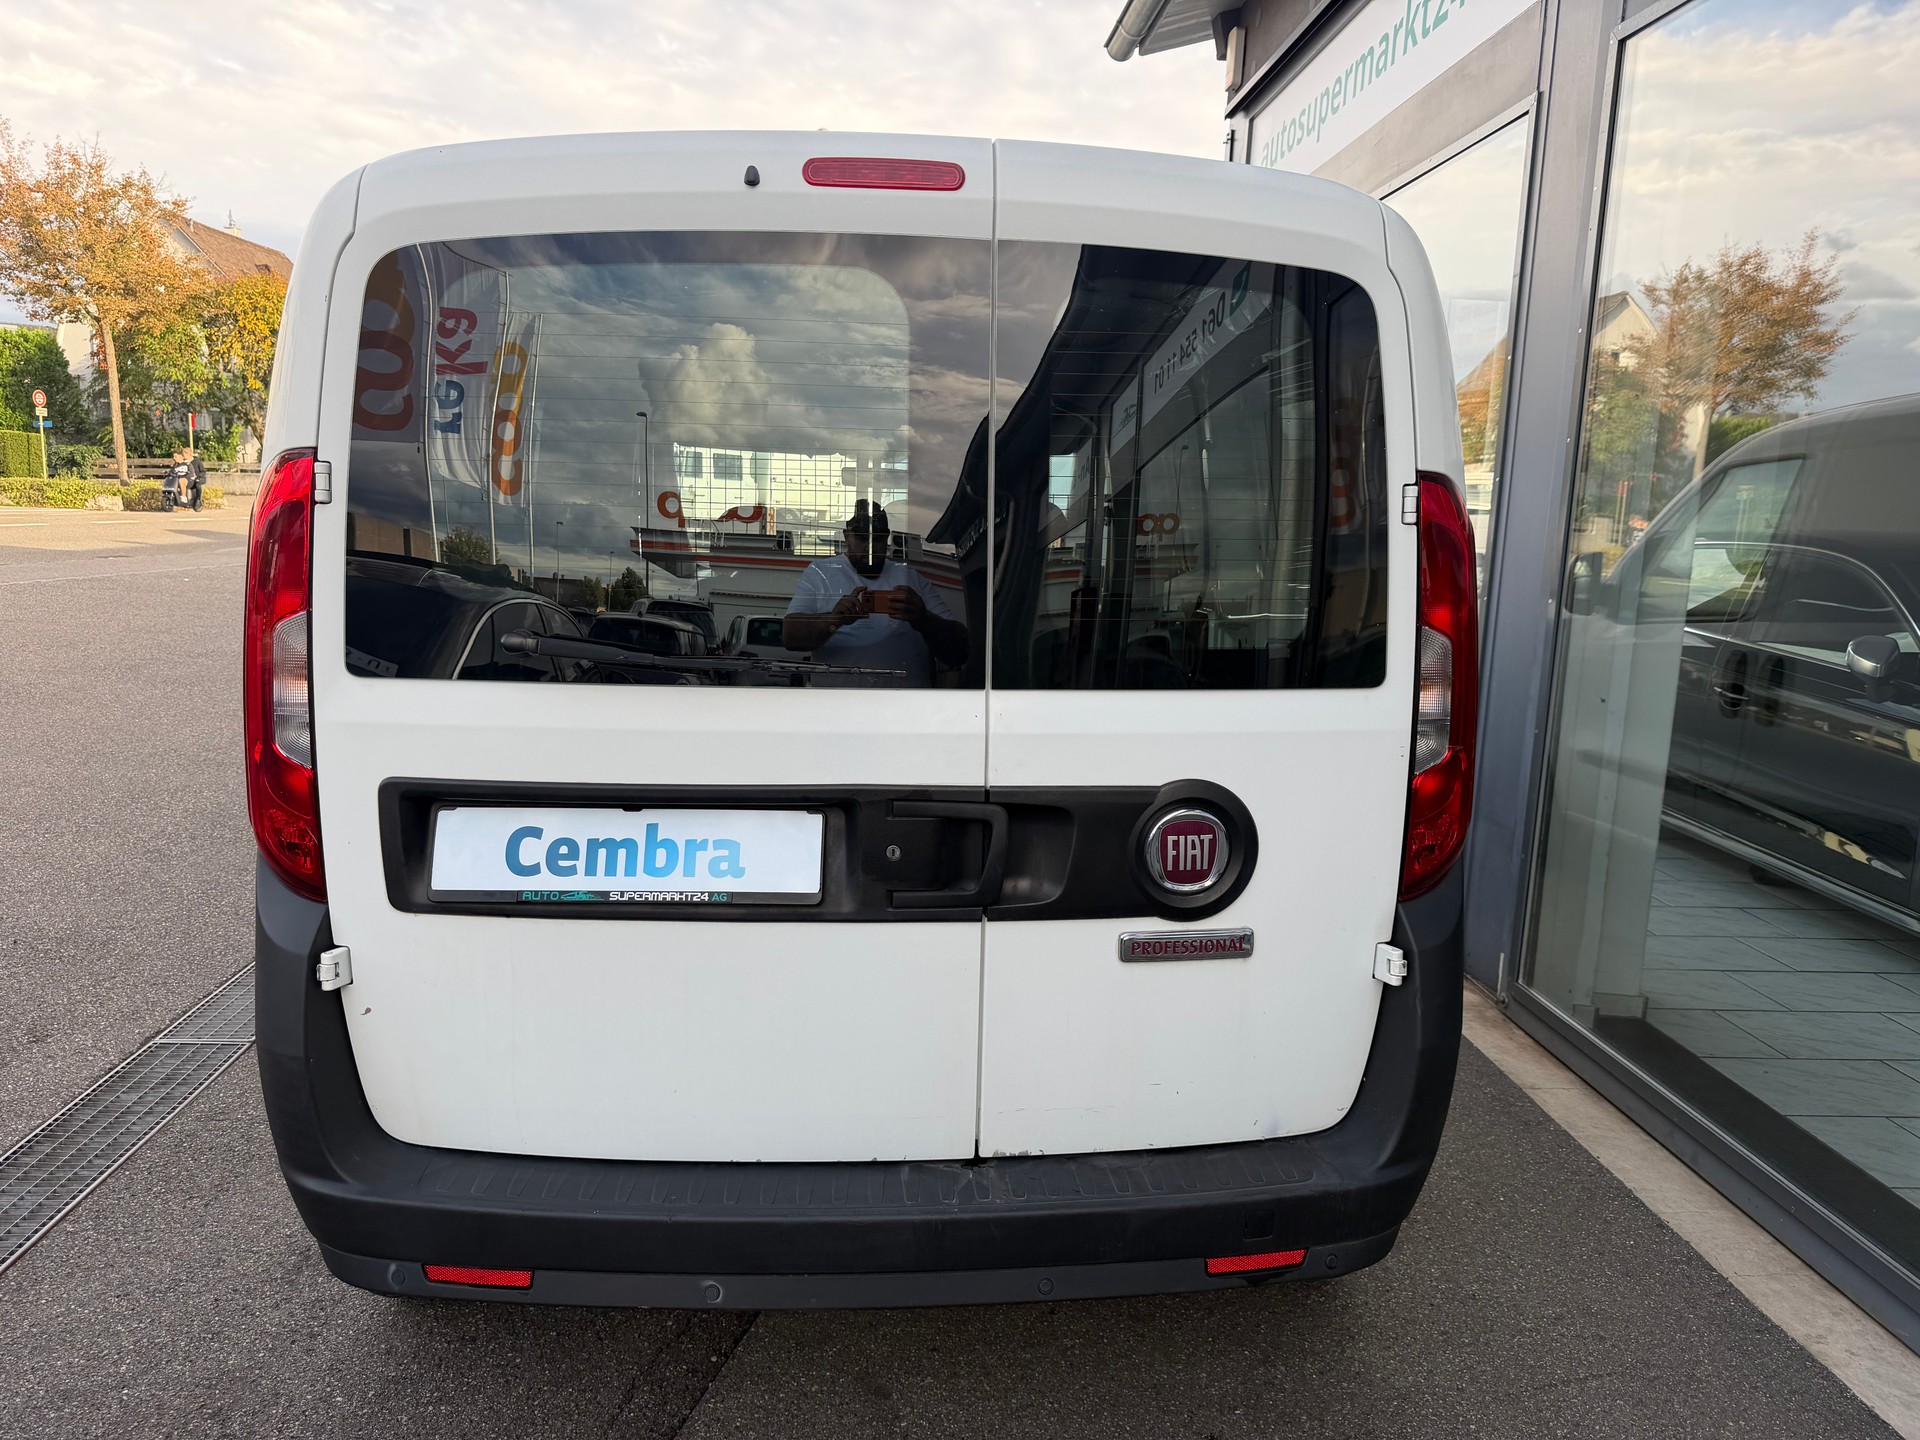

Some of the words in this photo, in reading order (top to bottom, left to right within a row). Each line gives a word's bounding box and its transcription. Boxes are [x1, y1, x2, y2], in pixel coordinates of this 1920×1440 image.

[1261, 0, 1466, 168] autosupermarkt2
[505, 823, 746, 879] Cembra
[1167, 834, 1213, 871] FIAT
[522, 890, 560, 901] AUTO
[609, 891, 709, 902] SUPERMARKT24
[711, 893, 728, 902] AG
[1131, 937, 1246, 957] PROFESSIONAL
